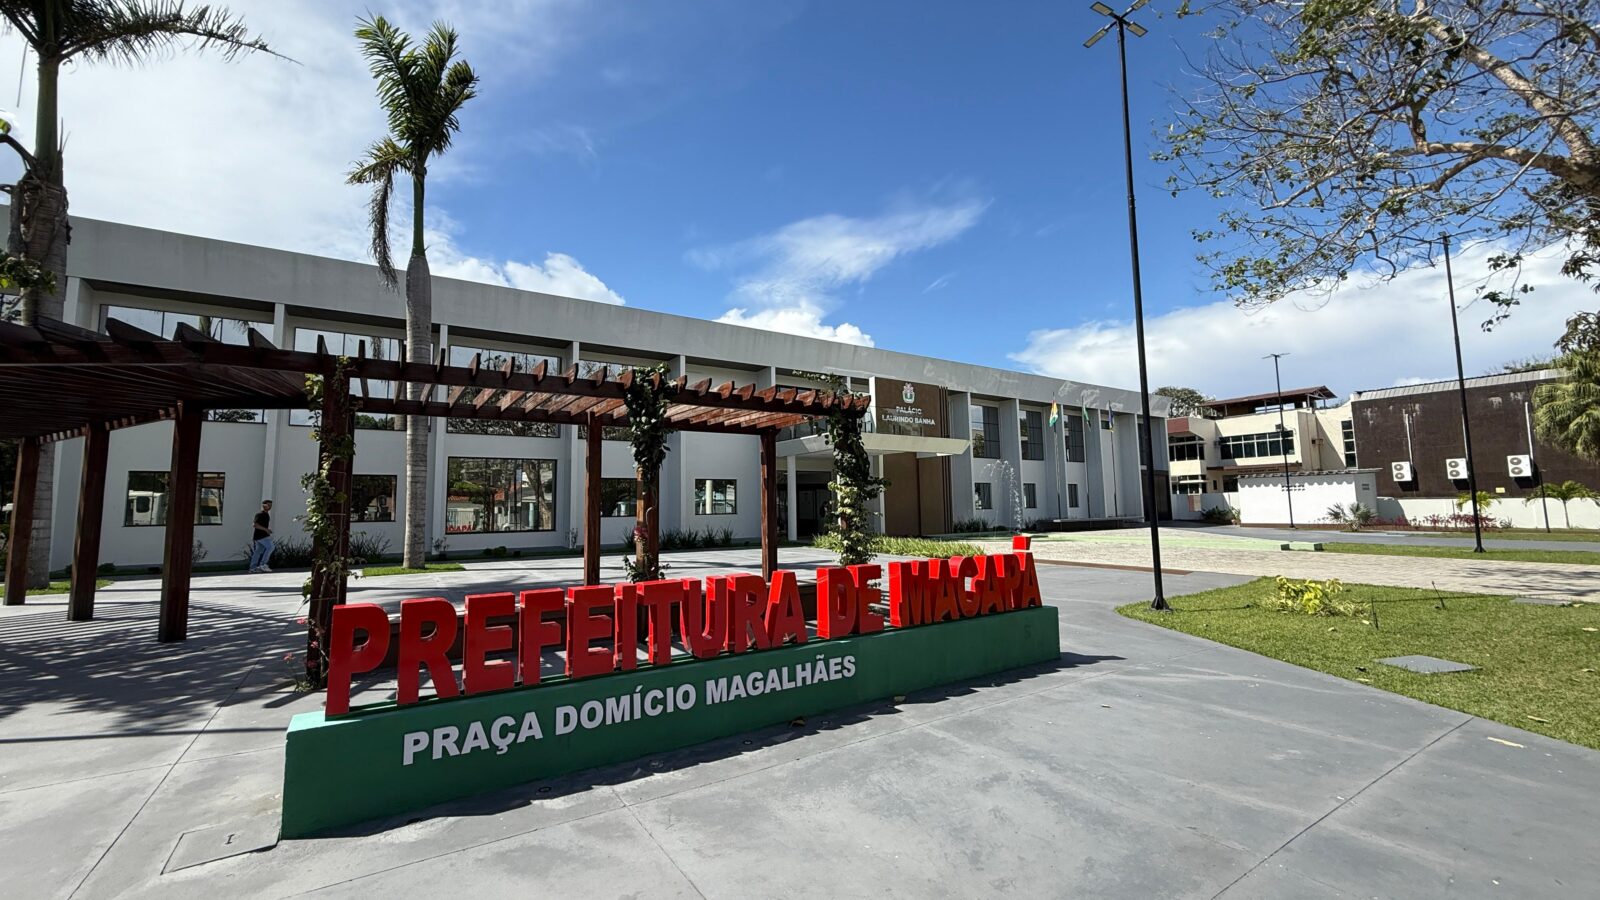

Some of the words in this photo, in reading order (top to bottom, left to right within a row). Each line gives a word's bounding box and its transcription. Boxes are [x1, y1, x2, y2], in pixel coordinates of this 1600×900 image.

[882, 415, 913, 423] LAURINDO
[896, 406, 922, 414] PALÁCIO
[325, 569, 808, 718] PREFEITURA
[816, 563, 884, 640] DE
[888, 536, 1043, 628] MACAPÁ
[402, 711, 543, 767] PRAÇA
[554, 684, 697, 736] DOMÍCIO
[705, 653, 857, 706] MAGALHÃES
